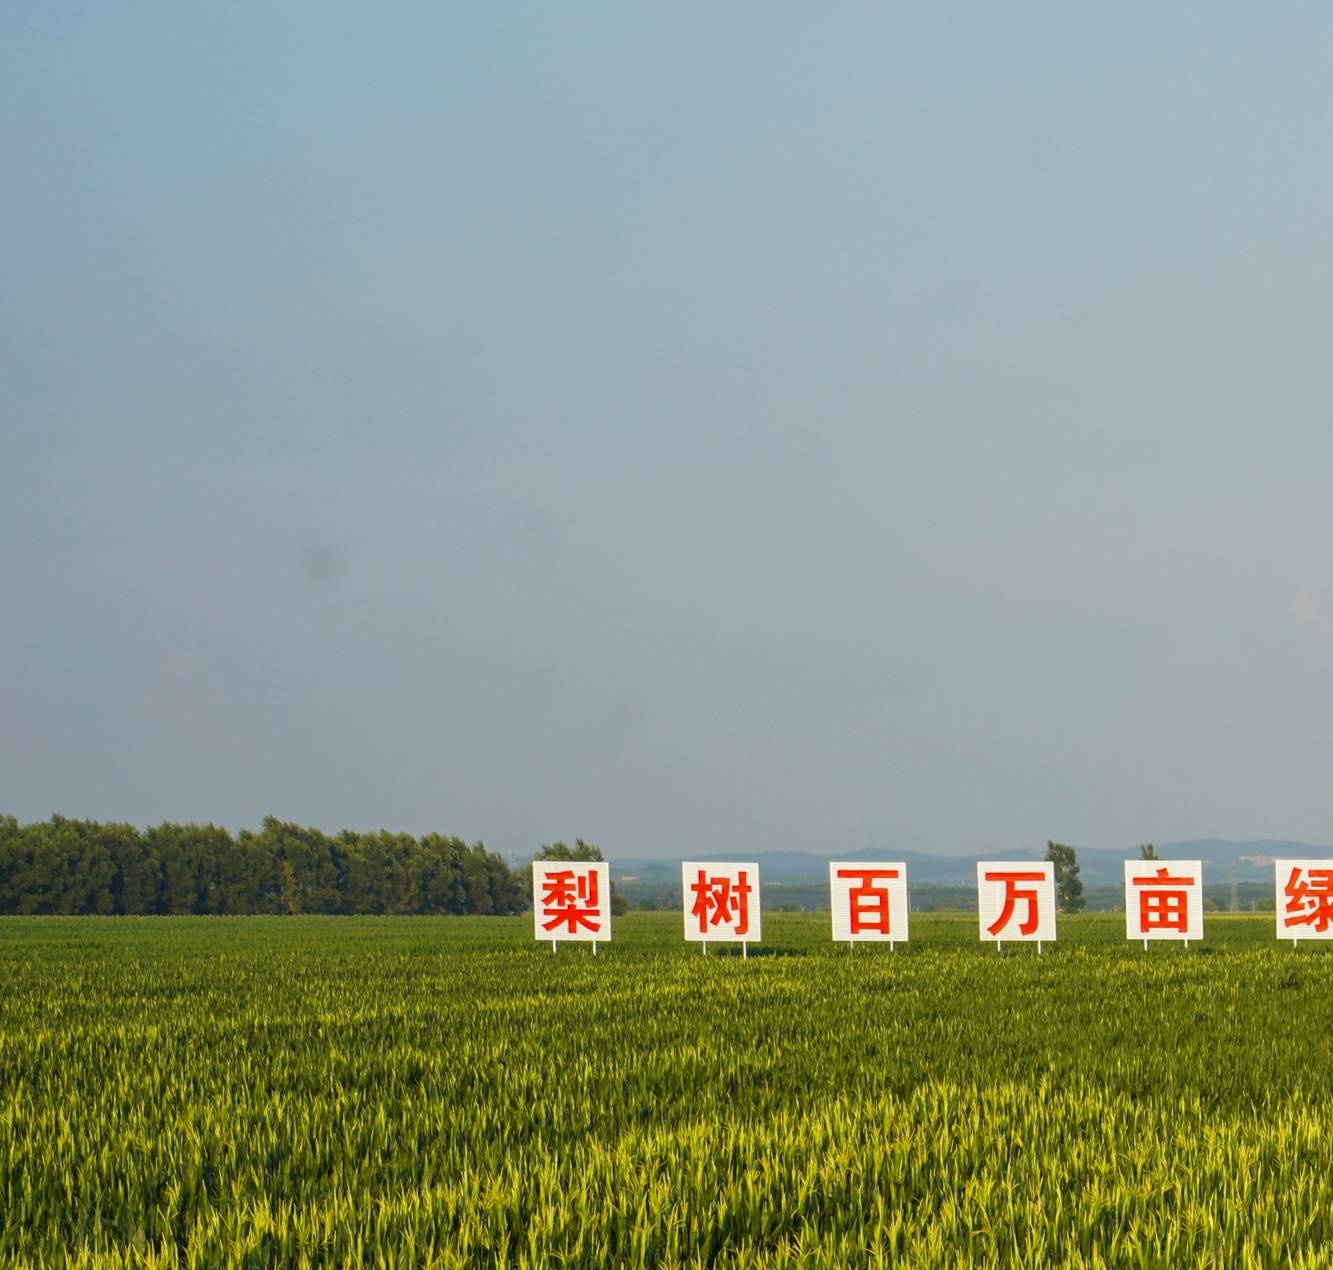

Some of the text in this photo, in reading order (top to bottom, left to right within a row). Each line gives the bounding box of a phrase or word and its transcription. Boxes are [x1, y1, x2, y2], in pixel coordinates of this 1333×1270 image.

[542, 869, 601, 934] 梨
[690, 869, 753, 935] 树
[836, 869, 899, 935] 百
[984, 871, 1045, 936] 万
[1132, 868, 1195, 933] 亩
